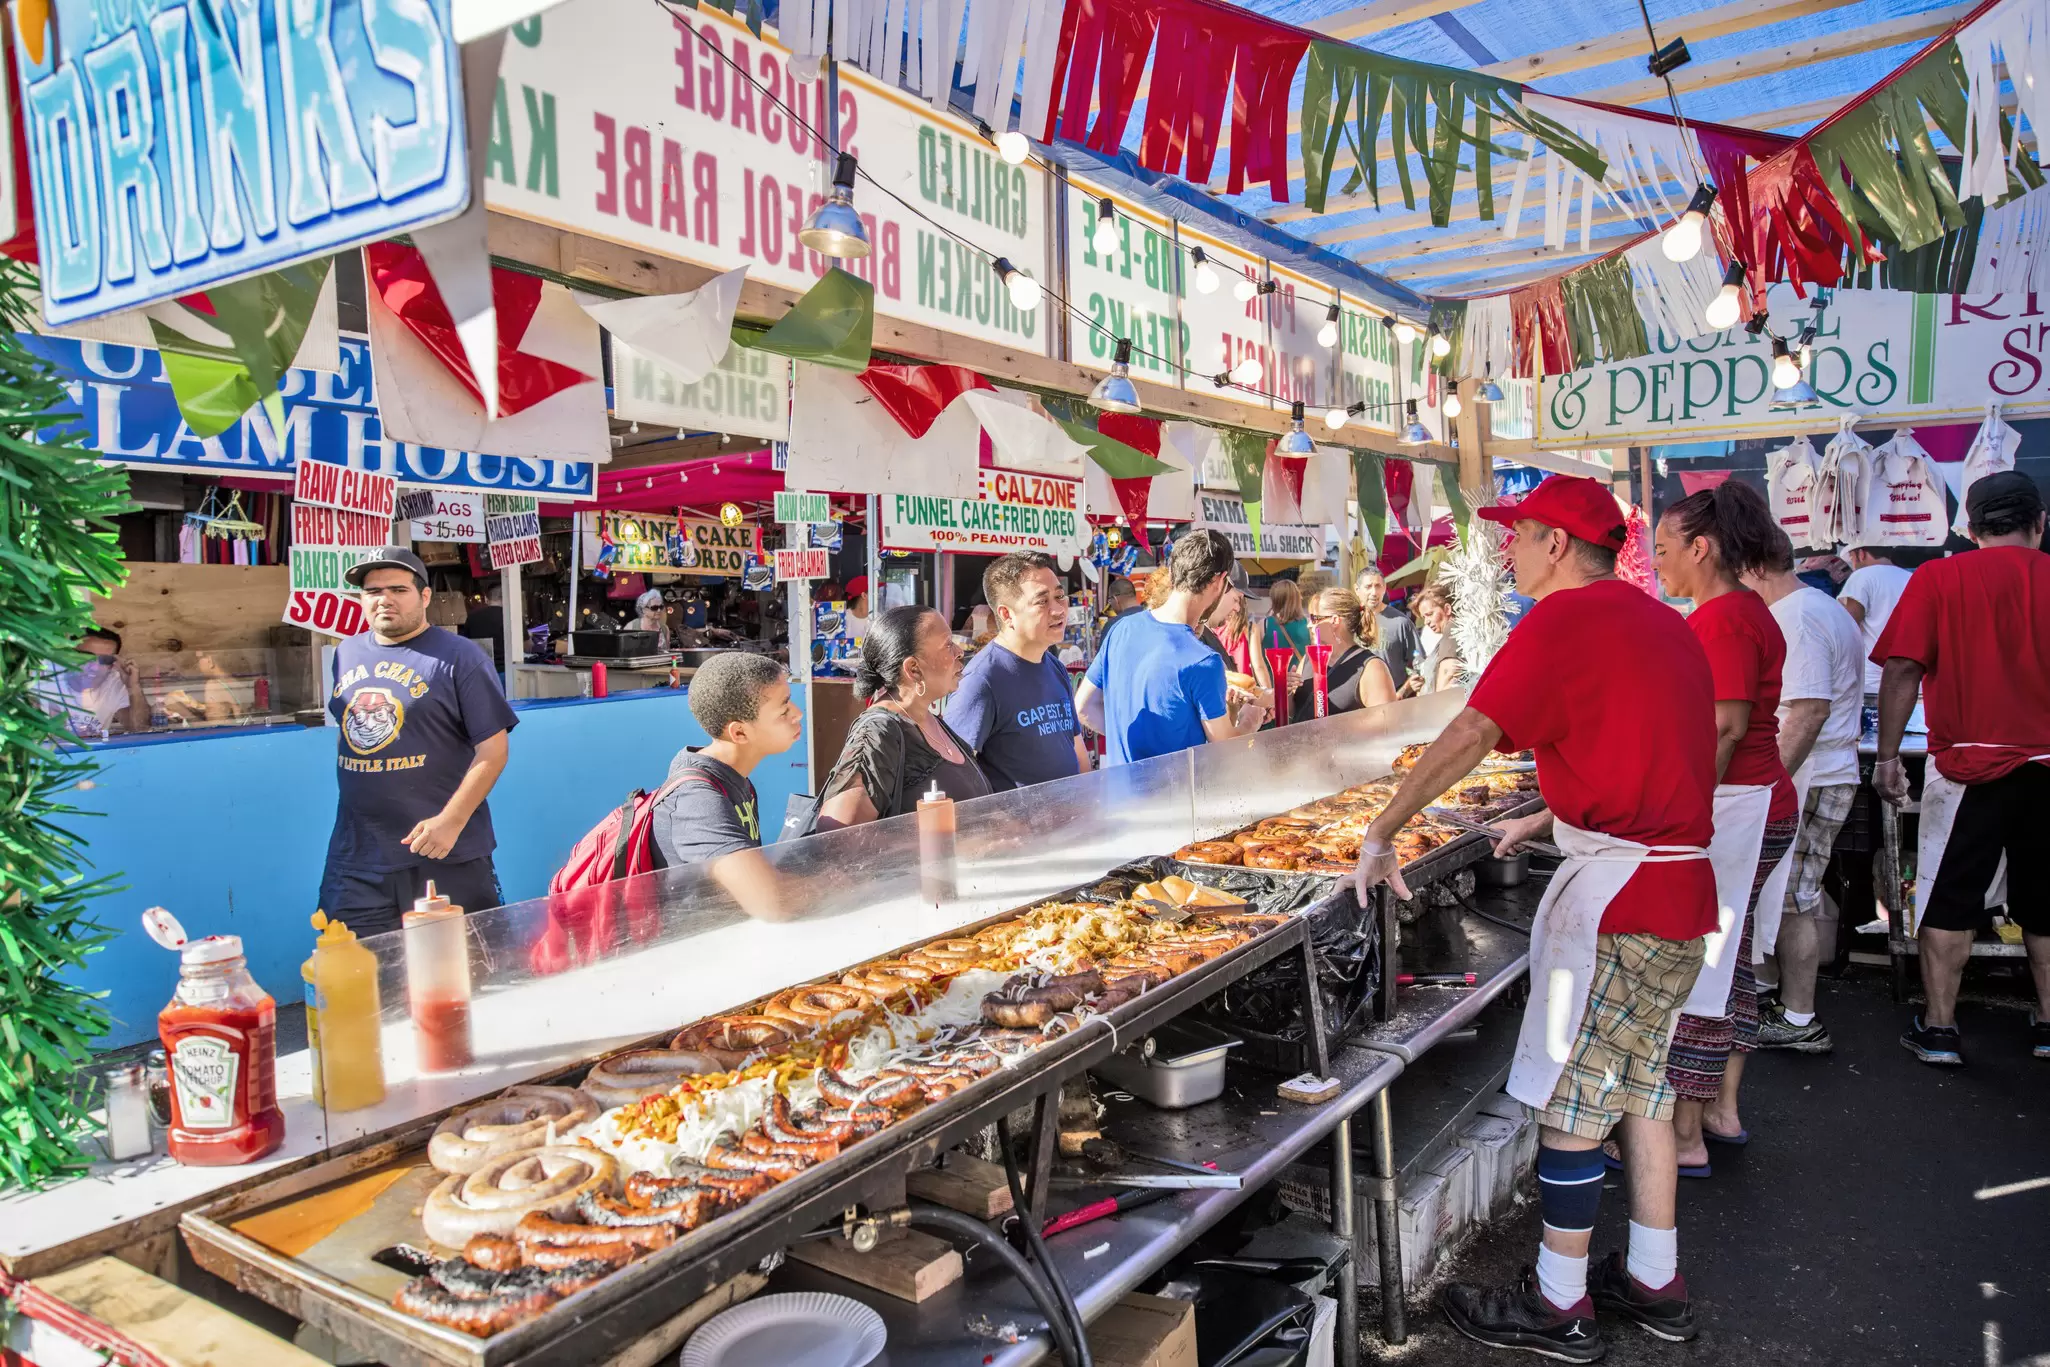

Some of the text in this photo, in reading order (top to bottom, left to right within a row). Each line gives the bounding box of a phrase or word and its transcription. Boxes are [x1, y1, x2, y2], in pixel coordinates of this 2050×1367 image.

[28, 0, 450, 302] DRINKS
[1551, 373, 1592, 430] &
[1605, 339, 1897, 426] PEPPRS
[340, 410, 588, 490] HOUSE
[300, 461, 338, 504] RAW
[341, 469, 394, 516] CLAMS
[995, 473, 1077, 510] CALZONE
[401, 491, 434, 520] SHRIMP
[437, 501, 472, 517] AGS
[487, 494, 536, 513] FISH SALAD
[777, 494, 827, 522] RAW CLAMS
[896, 494, 1075, 537] FUNNEL CAKE FRIED OREO
[295, 506, 334, 545] FRIED
[338, 510, 390, 546] SHRIMP
[488, 512, 539, 542] BAKED CLAMS
[695, 525, 753, 548] CAKE
[930, 530, 1048, 547] 100% PEANUT OIL
[492, 538, 541, 567] FRIED CLAMS
[1279, 535, 1314, 554] SHACK
[293, 550, 338, 589] BAKED
[694, 549, 742, 570] REO
[778, 550, 827, 578] FRIED CALAMARI
[333, 660, 430, 698] CHA CHA'S
[1017, 705, 1046, 727] GAP
[1046, 703, 1063, 719] EST.
[1038, 720, 1057, 736] NEW
[343, 757, 384, 773] LITTLE
[386, 754, 427, 771] ITALY
[186, 1048, 216, 1058] HEINZ
[182, 1064, 225, 1077] TOMATO
[186, 1075, 223, 1086] ETCHUP
